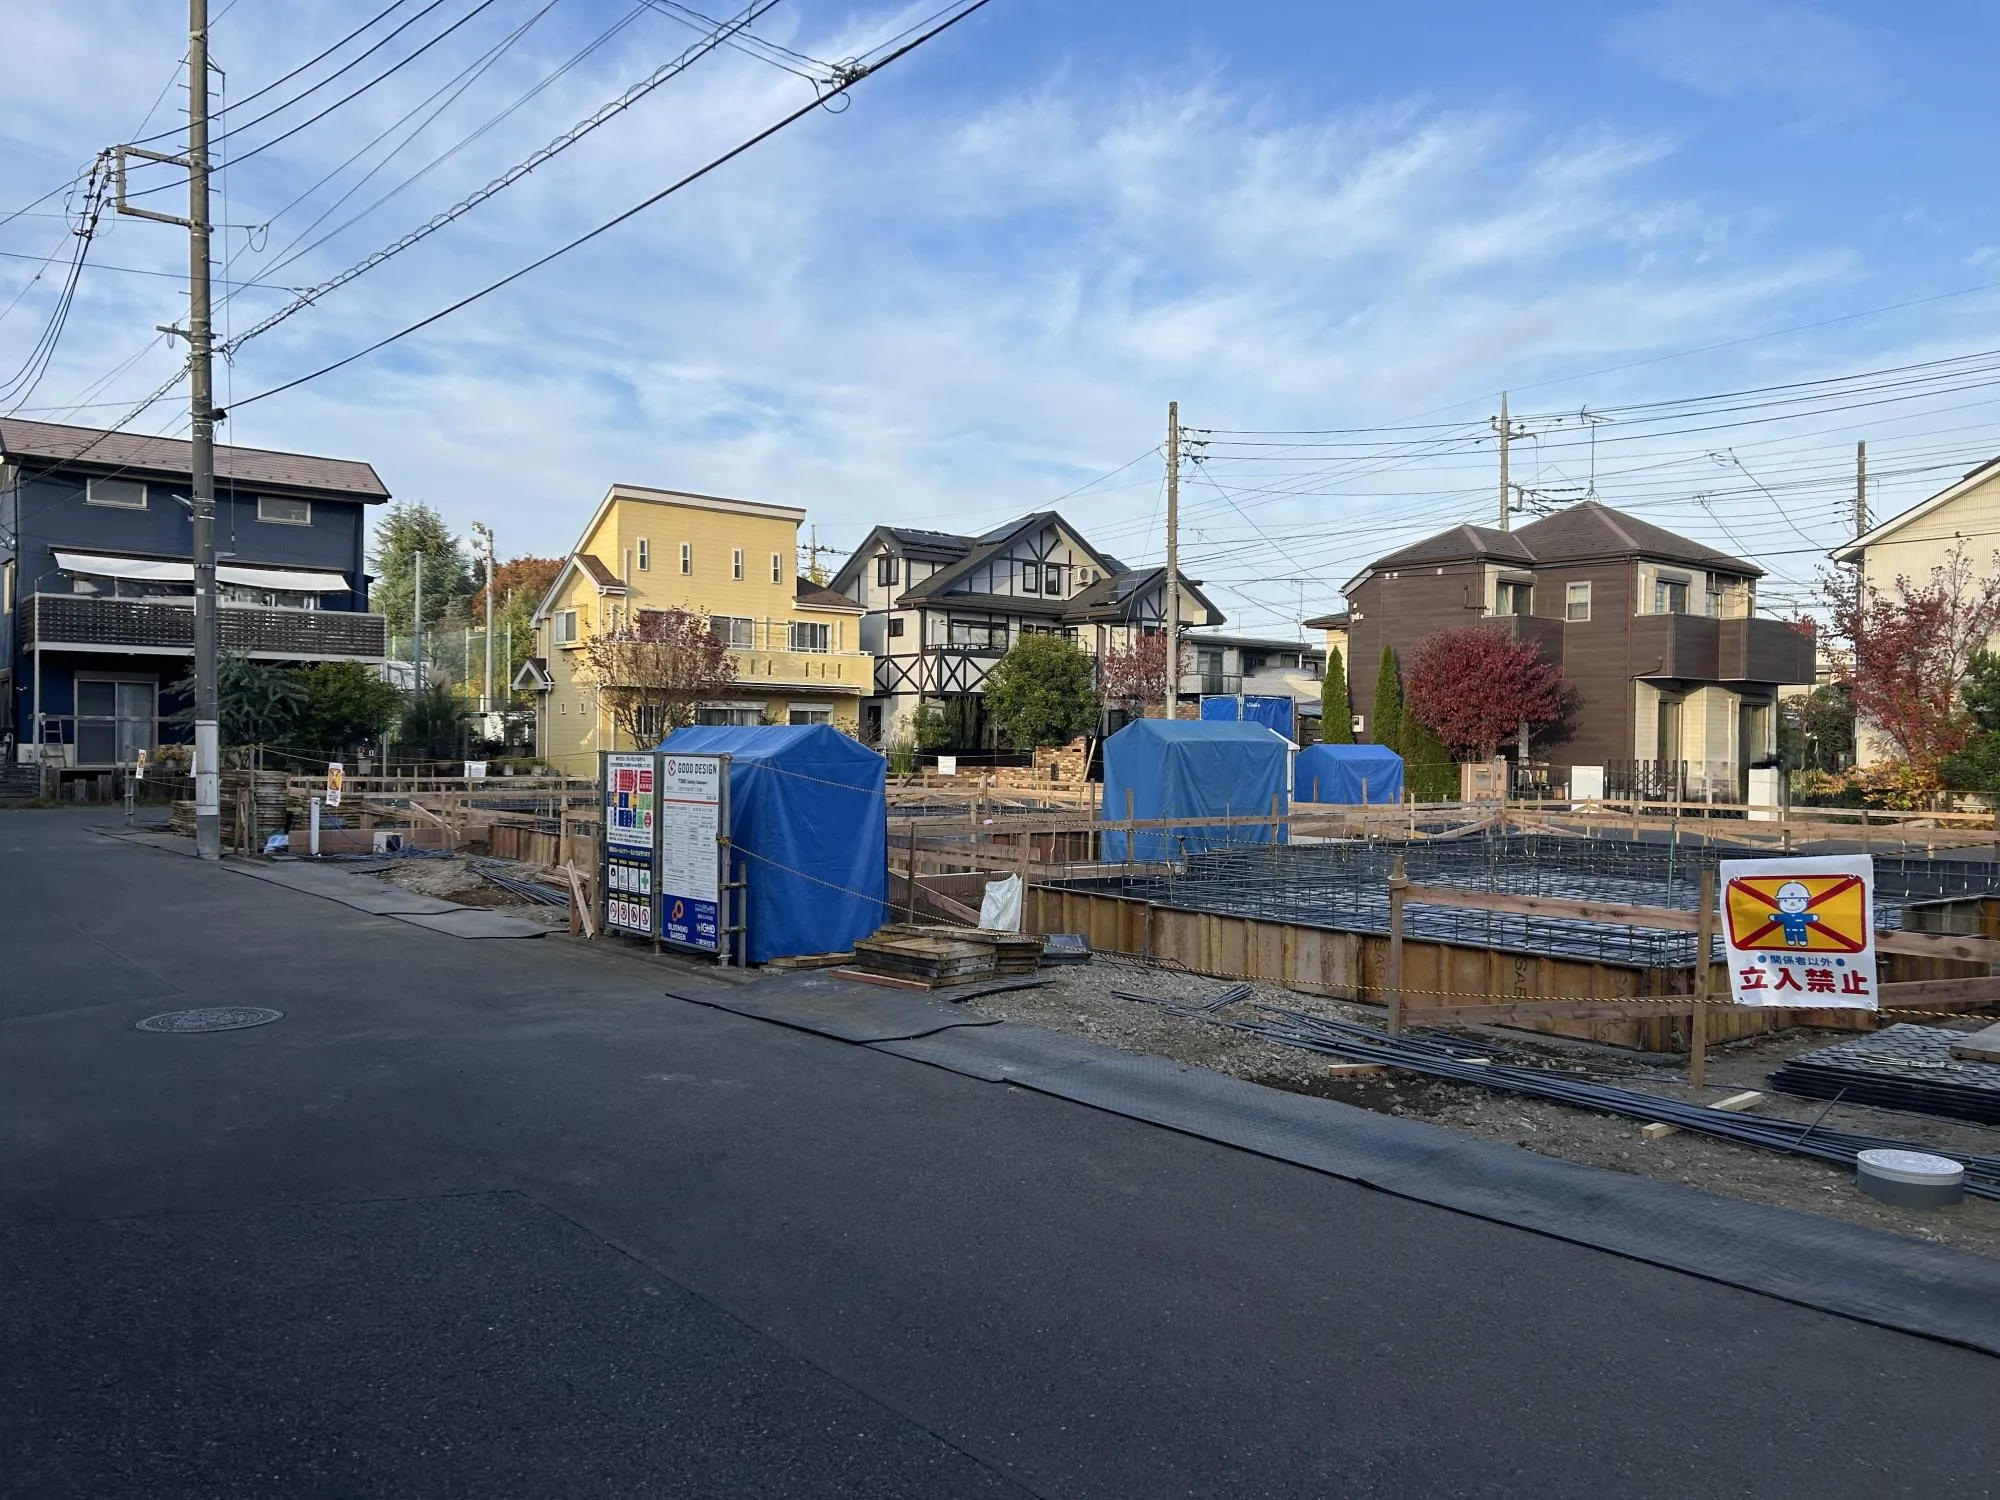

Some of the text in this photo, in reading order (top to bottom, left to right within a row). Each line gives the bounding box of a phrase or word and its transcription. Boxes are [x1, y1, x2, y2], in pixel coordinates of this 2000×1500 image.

[678, 763, 717, 774] GOOD DESIGN
[1769, 954, 1833, 967] 関係者以外
[1739, 966, 1870, 996] 立入禁止
